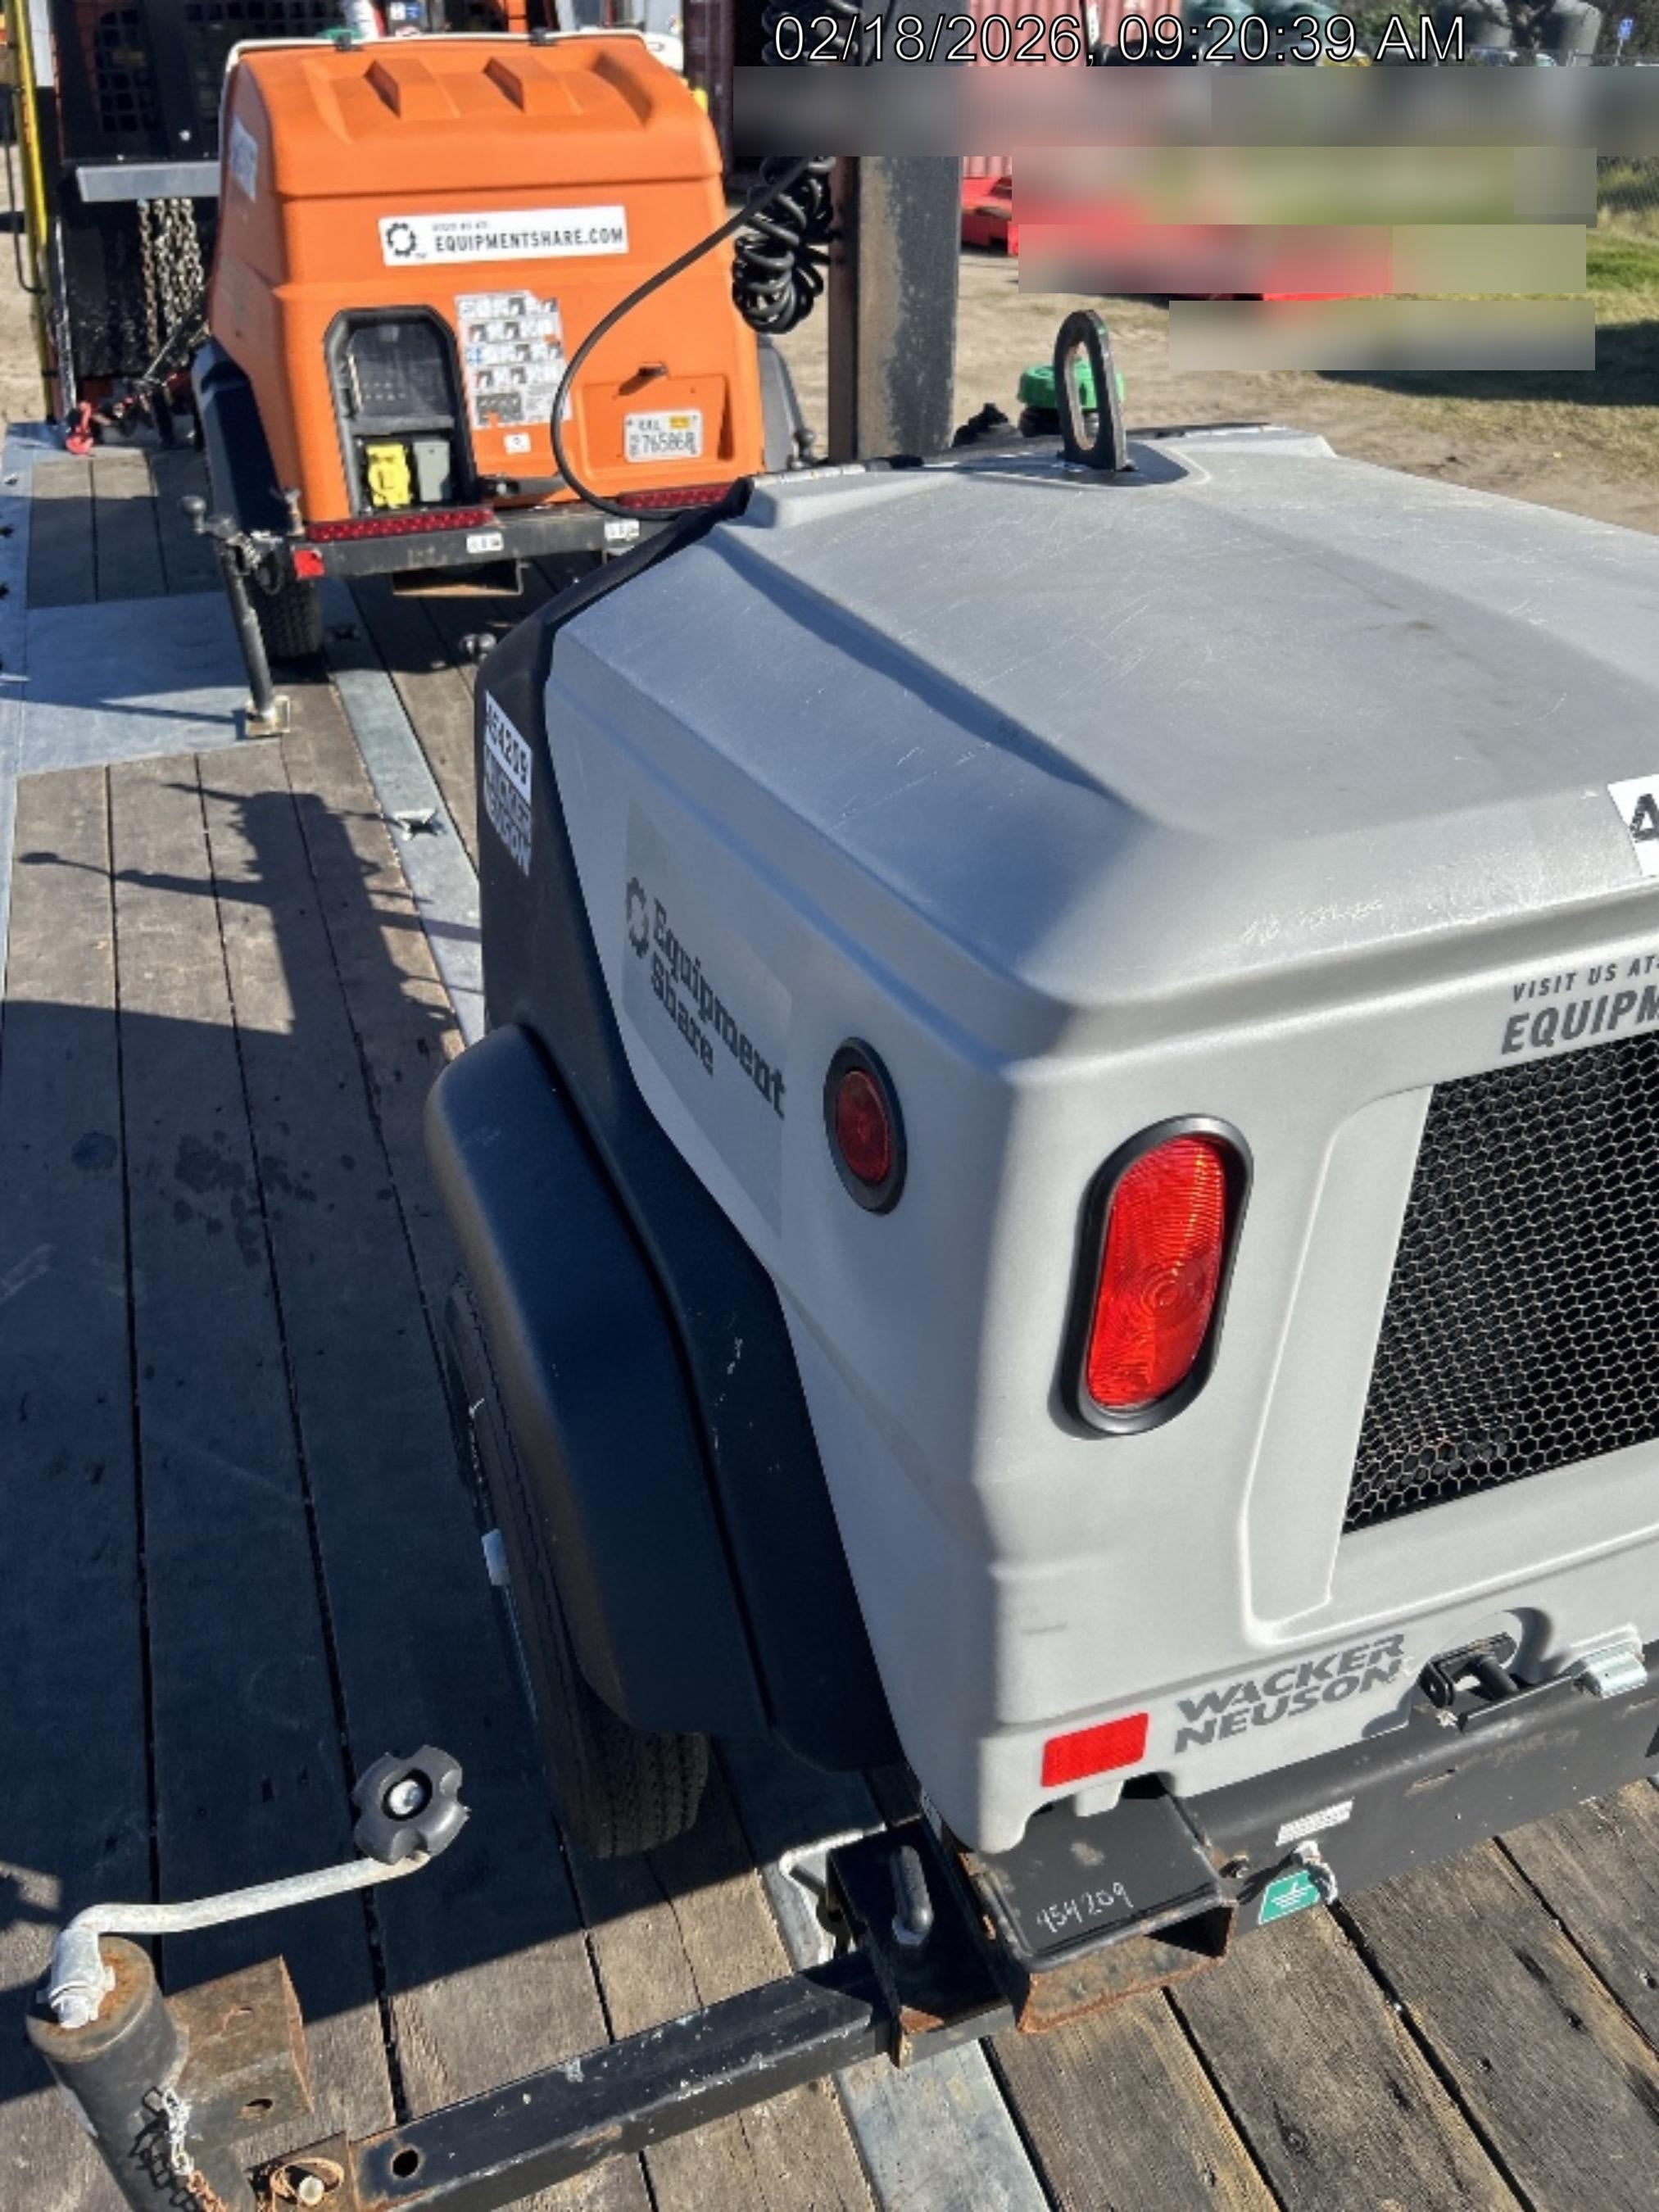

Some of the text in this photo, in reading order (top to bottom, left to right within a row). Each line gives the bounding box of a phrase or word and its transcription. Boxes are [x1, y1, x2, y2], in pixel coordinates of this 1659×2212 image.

[436, 227, 623, 252] EQUIPMENTSHARE.COM
[651, 950, 714, 1077] Share
[654, 897, 785, 1121] Equipment
[1513, 972, 1576, 1003] VISIT
[1589, 963, 1616, 986] US
[1174, 1659, 1402, 1753] NEUSON
[1177, 1634, 1404, 1722] WACKER
